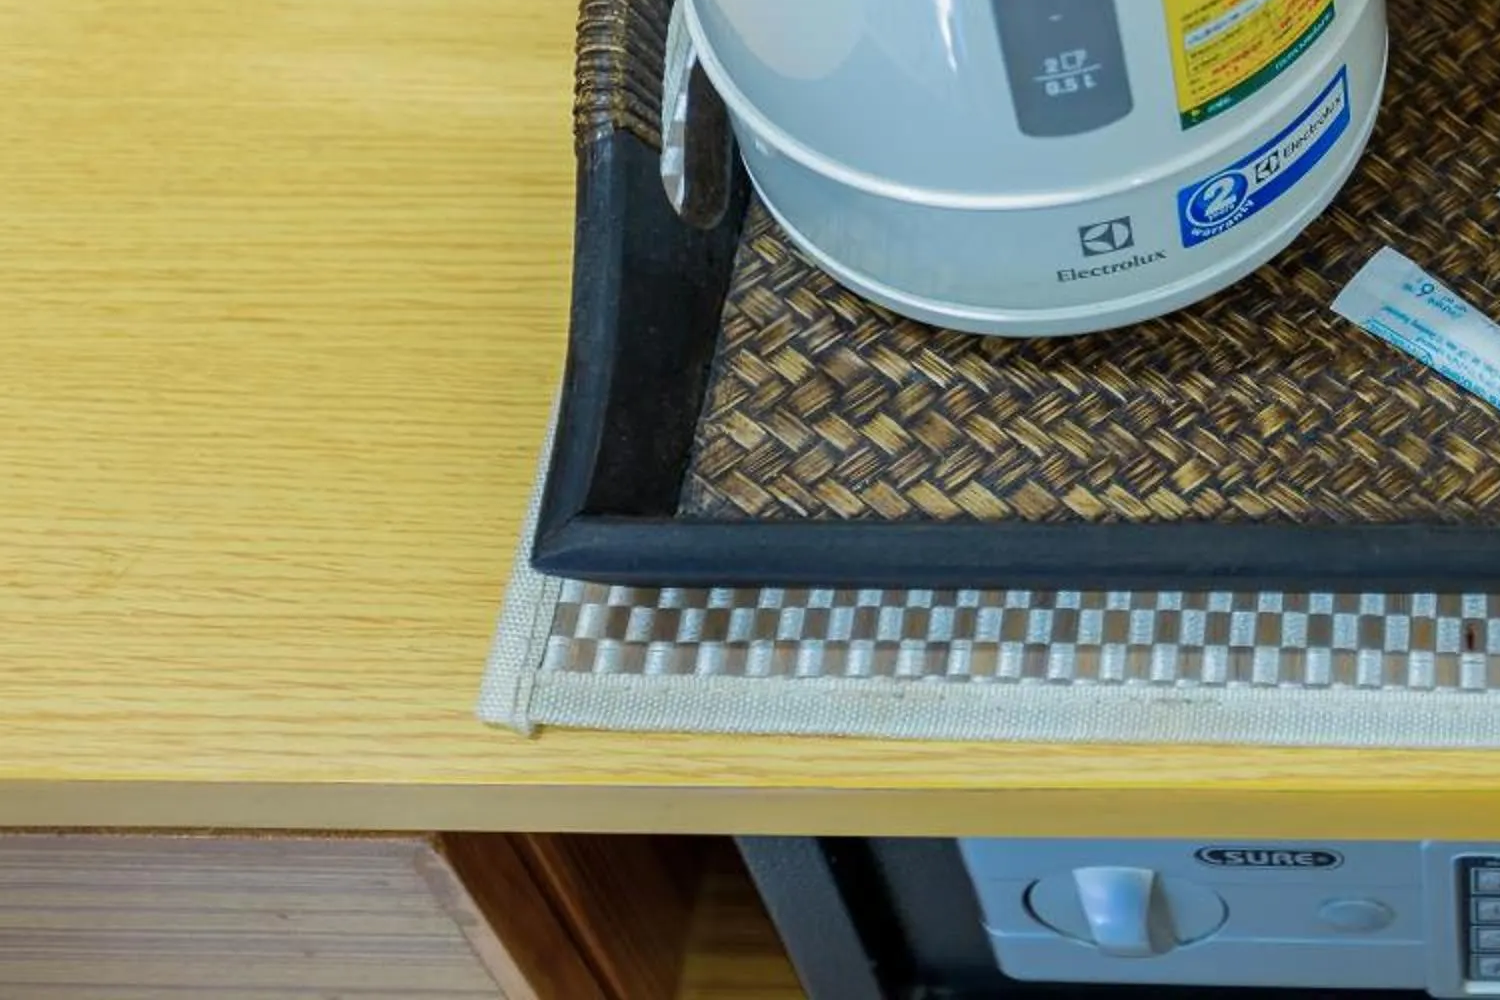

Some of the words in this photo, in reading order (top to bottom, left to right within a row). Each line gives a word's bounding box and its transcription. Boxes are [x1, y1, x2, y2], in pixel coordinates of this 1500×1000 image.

[1283, 97, 1341, 158] Electrolux
[1203, 176, 1237, 218] 2
[1056, 250, 1167, 283] Electrolux
[1224, 851, 1313, 865] SURE
